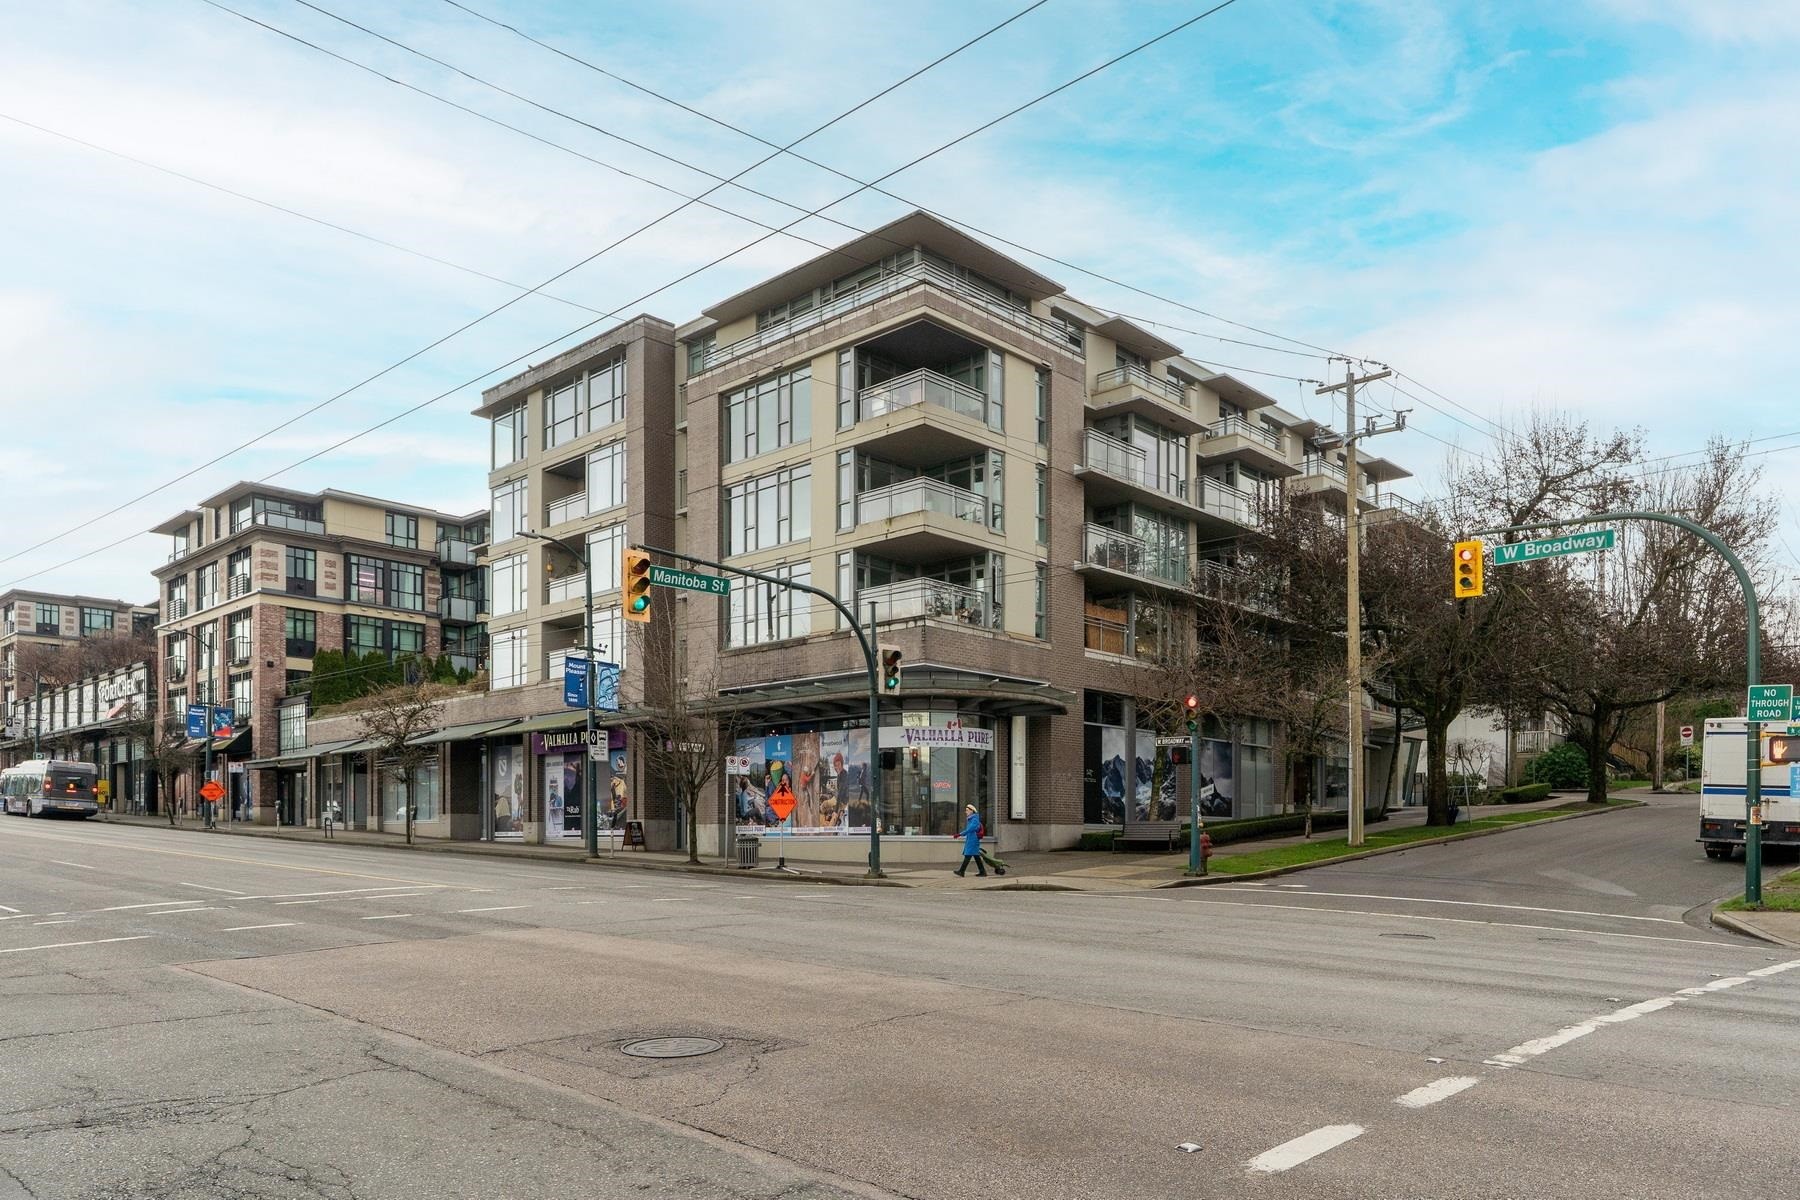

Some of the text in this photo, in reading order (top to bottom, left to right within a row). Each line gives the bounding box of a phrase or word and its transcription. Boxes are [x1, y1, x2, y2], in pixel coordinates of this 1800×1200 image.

[1502, 535, 1605, 560] W Broadway
[653, 569, 725, 592] Manitoba St
[568, 662, 586, 670] Mount
[1763, 688, 1777, 697] NO
[1750, 699, 1790, 708] THROUGH
[1756, 709, 1782, 718] ROAD
[544, 732, 578, 751] VALHALLA
[905, 728, 990, 746] VALHALLA PURE
